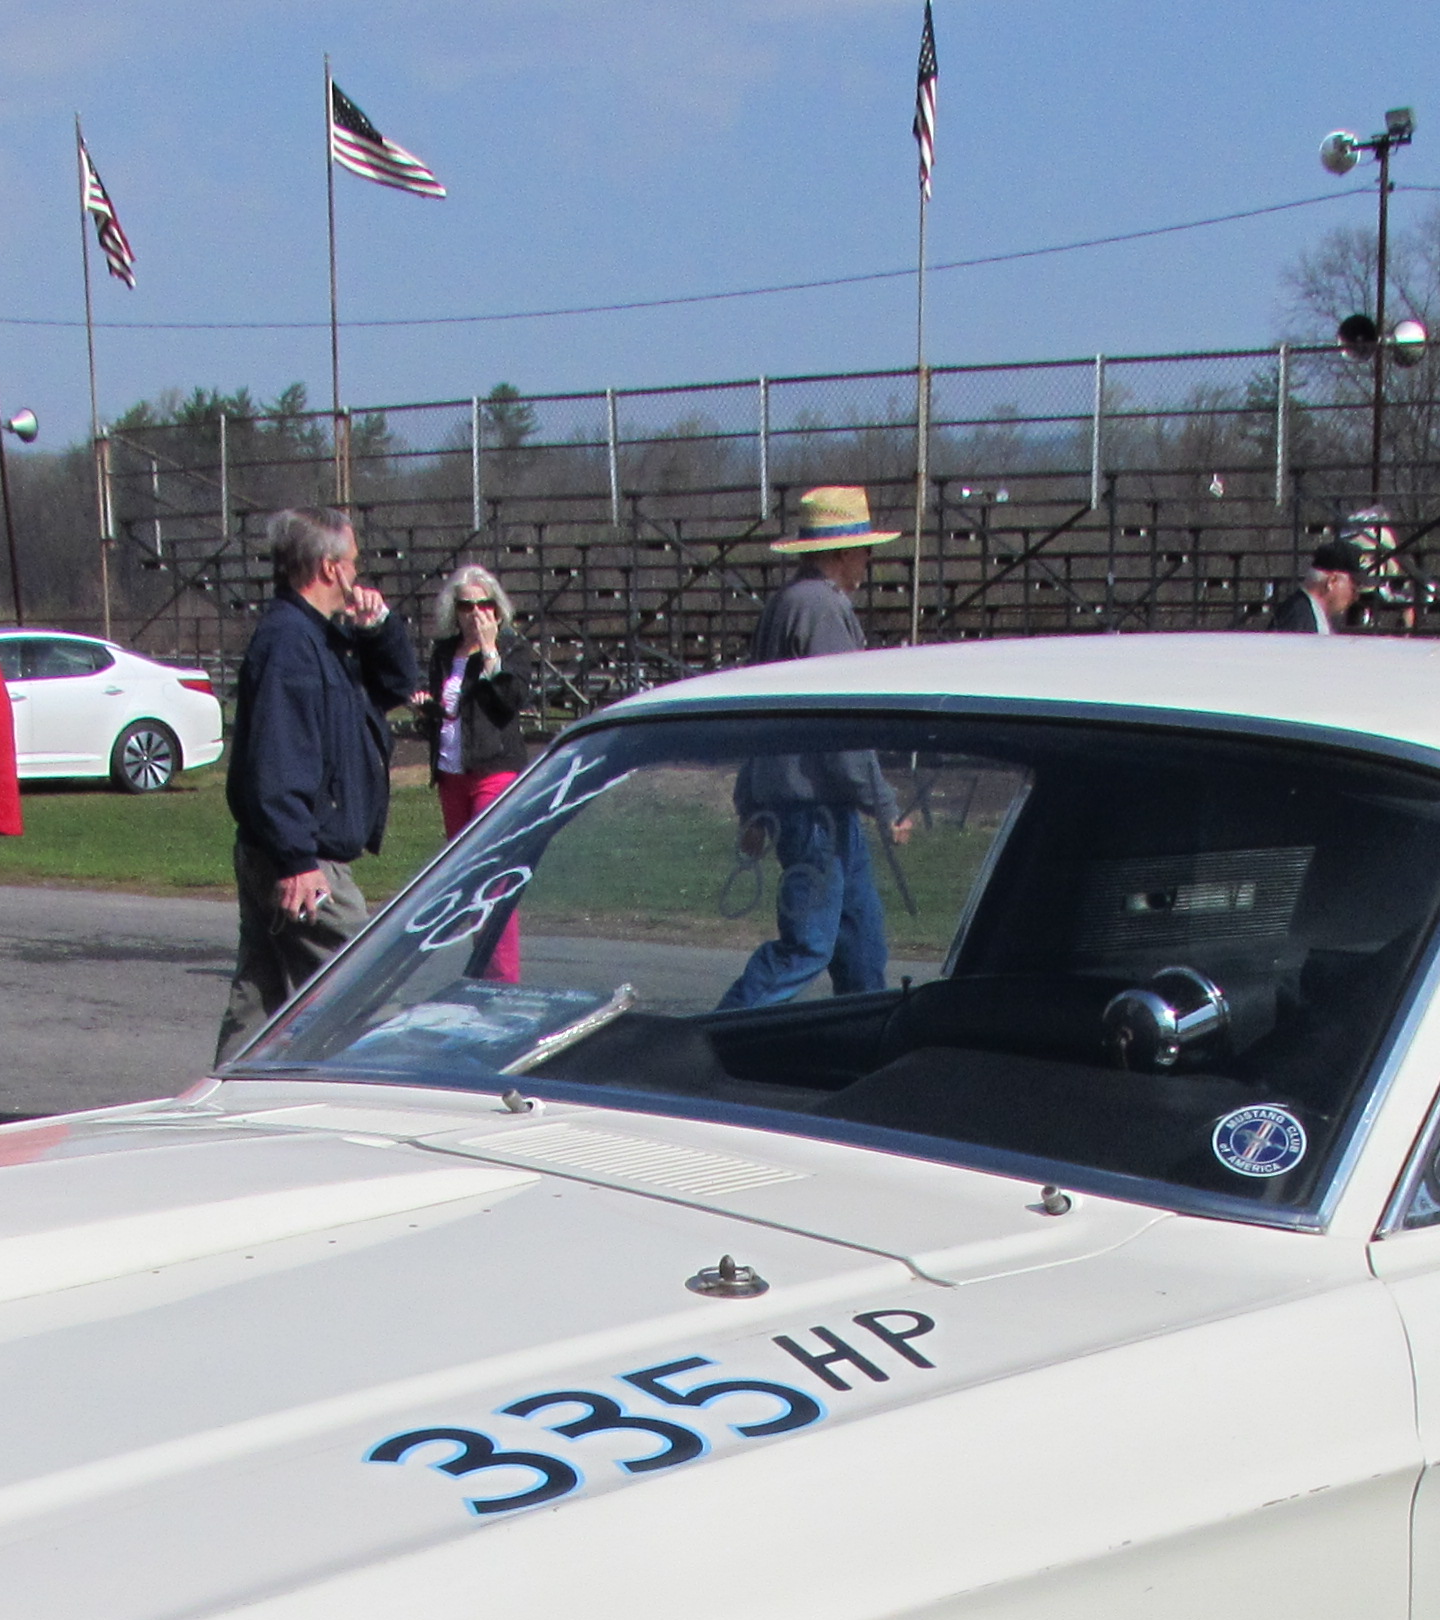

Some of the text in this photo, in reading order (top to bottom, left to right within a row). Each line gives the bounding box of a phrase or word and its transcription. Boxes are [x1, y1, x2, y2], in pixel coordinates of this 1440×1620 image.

[1227, 1111, 1301, 1152] MUSTANG CLUB
[1228, 1156, 1281, 1172] AMERICA
[361, 1309, 937, 1517] 335 HP
